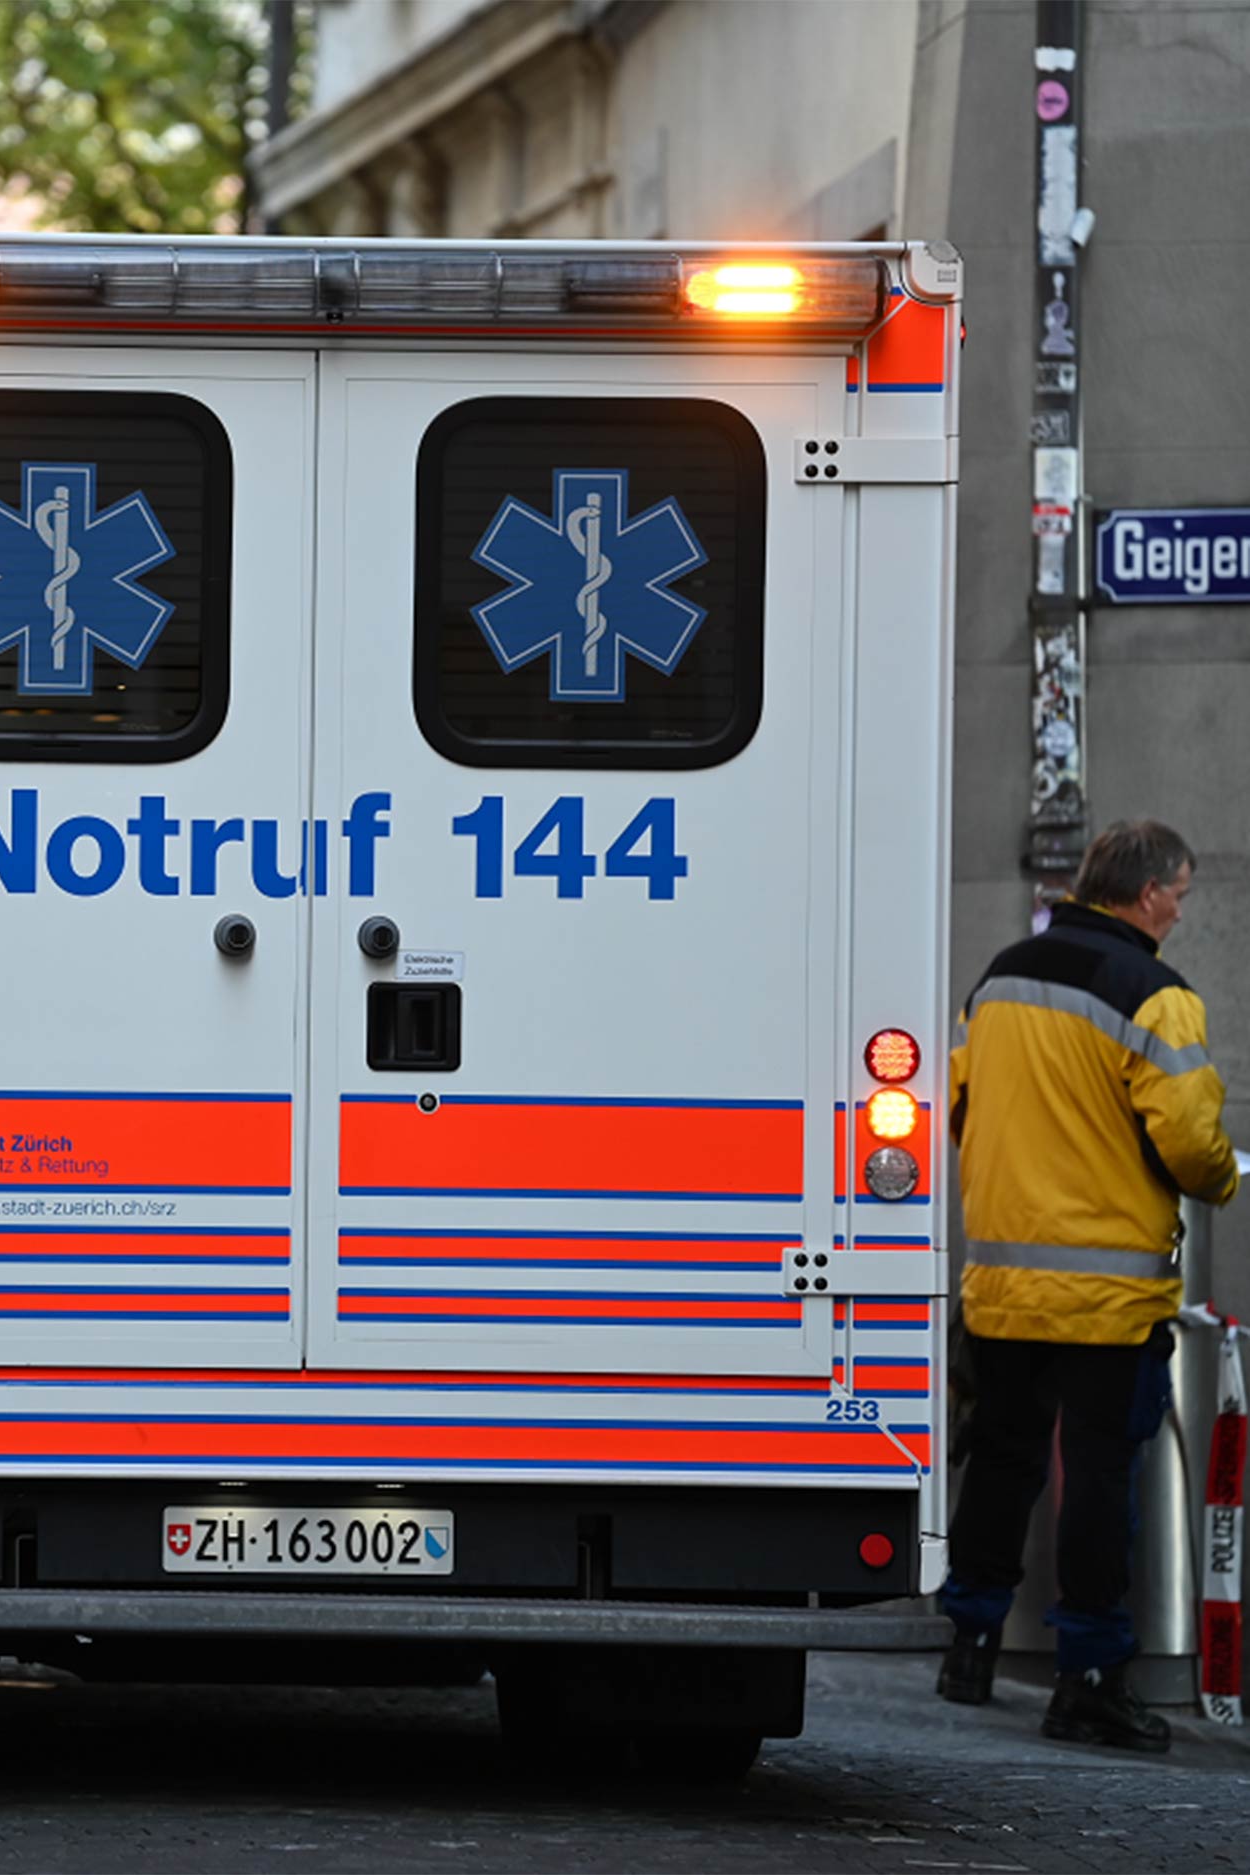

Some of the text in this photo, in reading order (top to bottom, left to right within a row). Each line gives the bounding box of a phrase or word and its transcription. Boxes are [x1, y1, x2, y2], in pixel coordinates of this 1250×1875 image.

[453, 796, 687, 900] 144
[11, 1134, 73, 1153] Zürich
[20, 1156, 33, 1174] &
[38, 1156, 109, 1178] Rettung
[826, 1400, 879, 1421] 253
